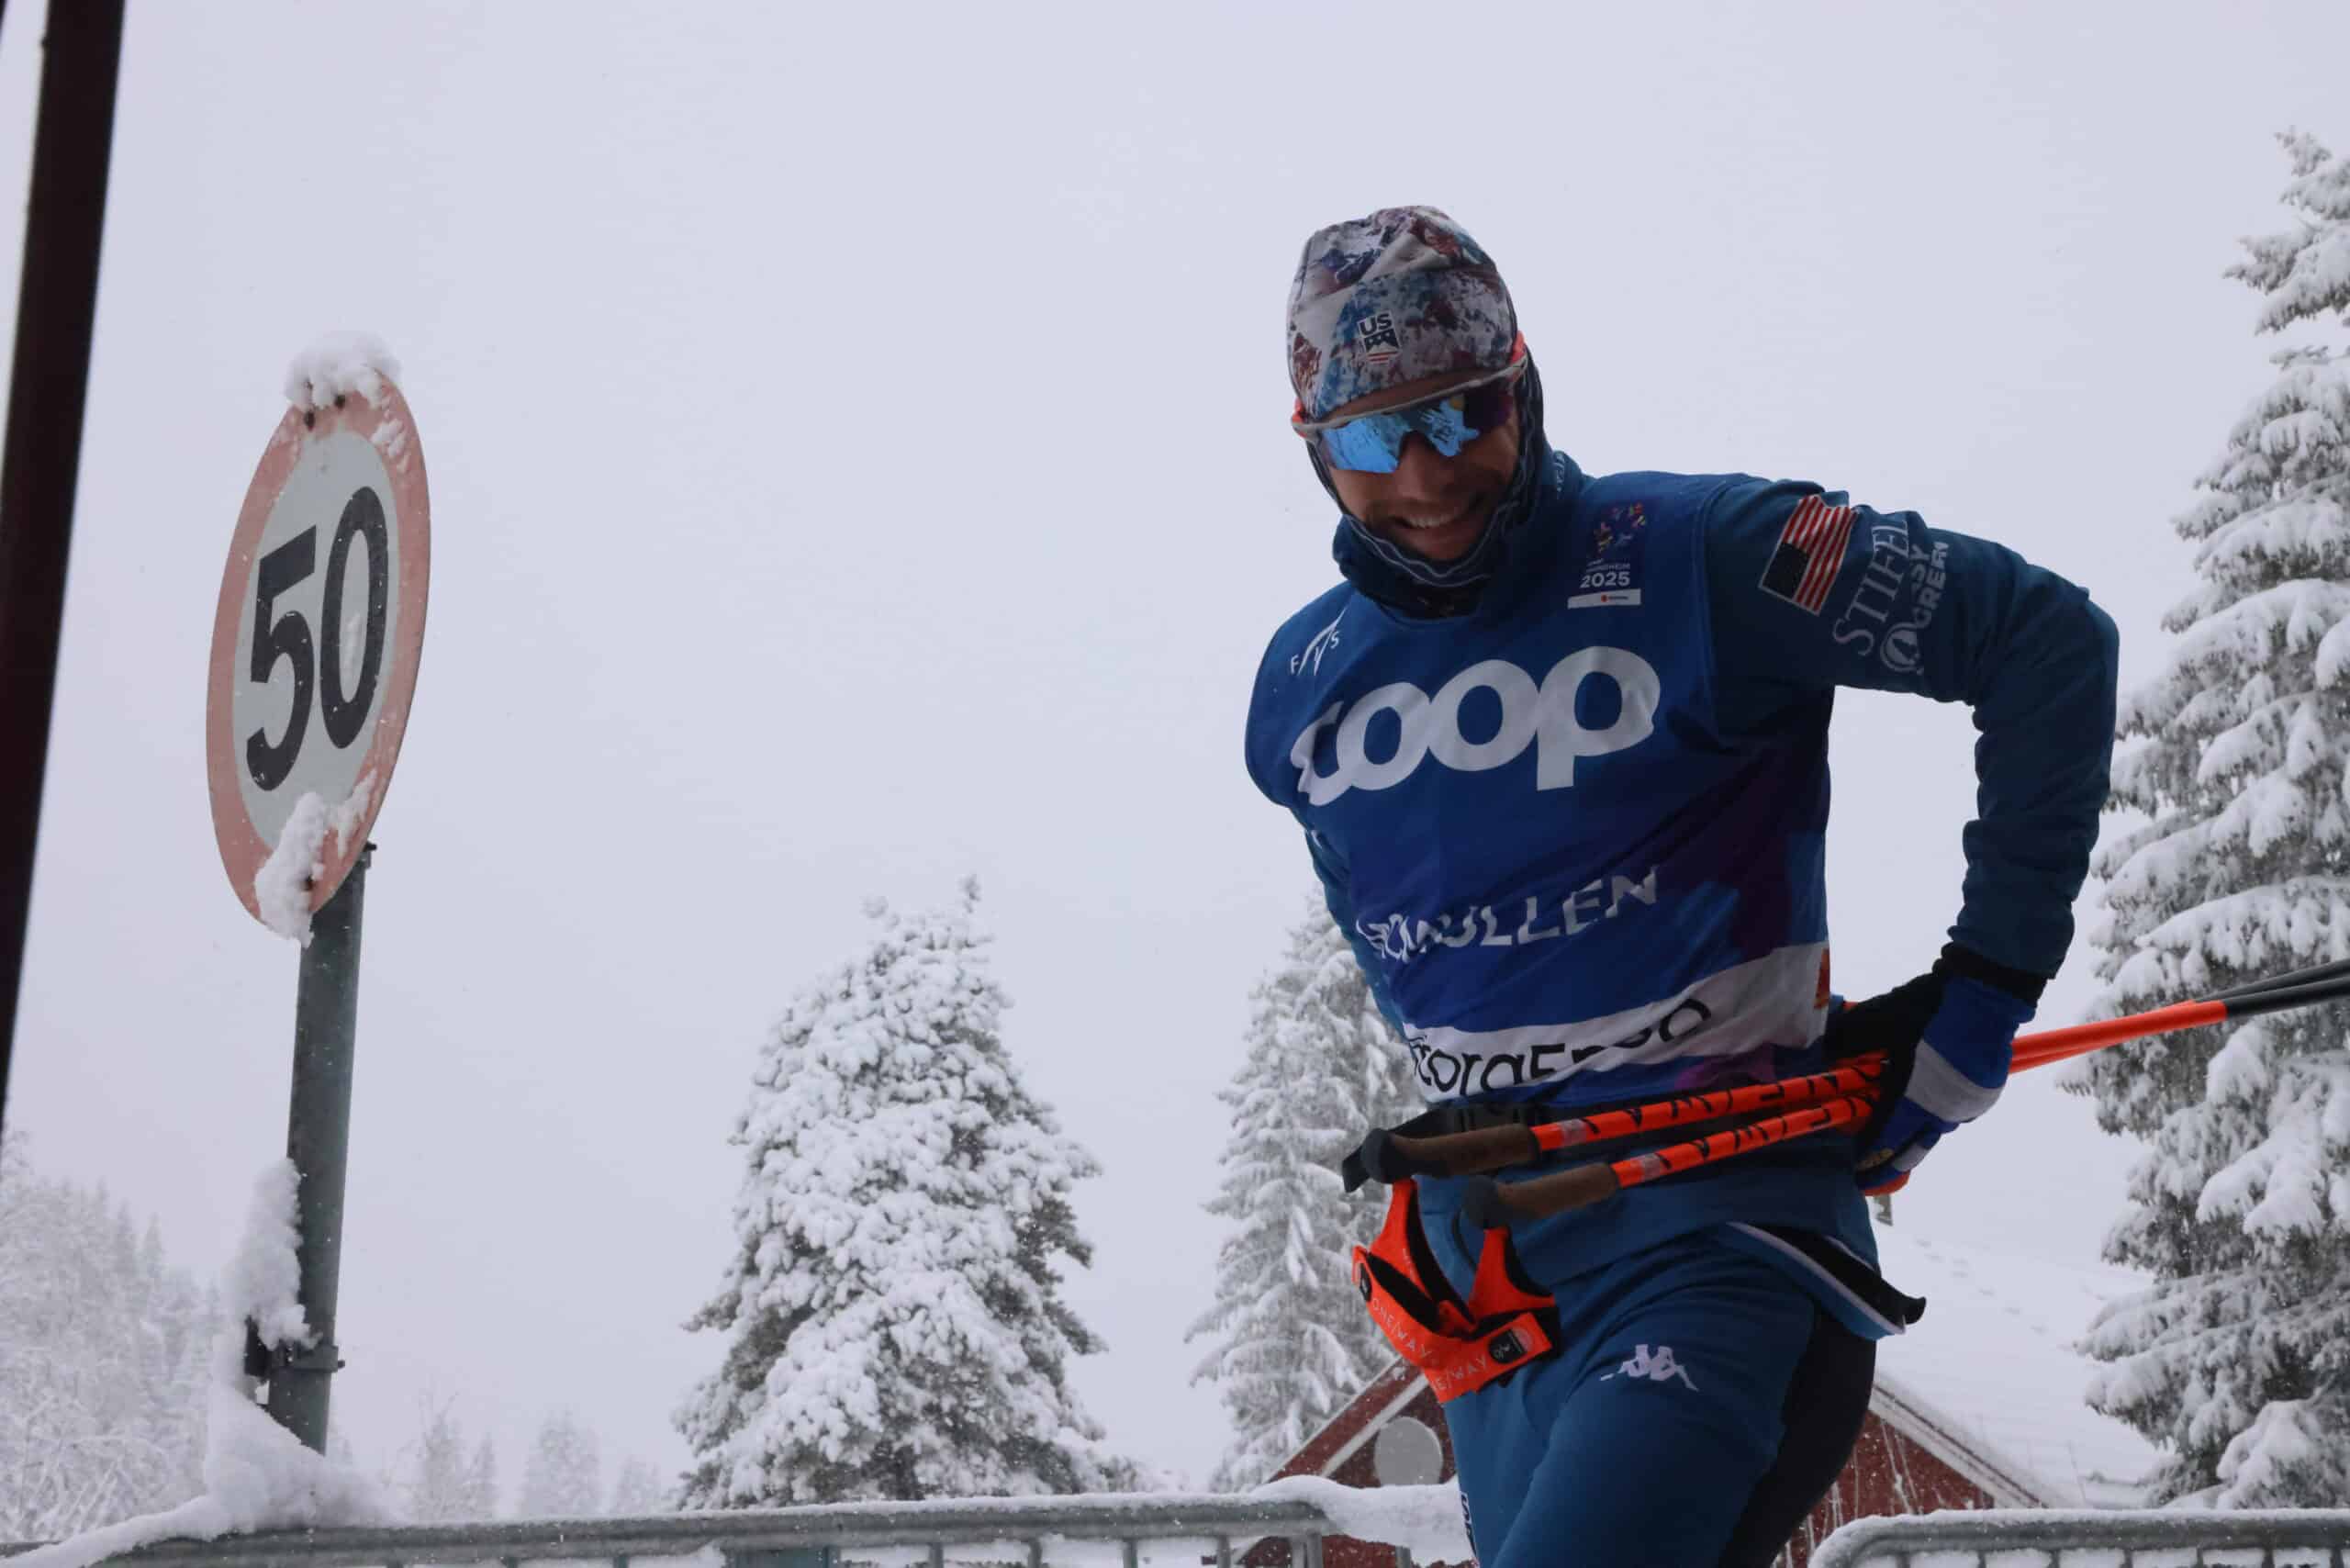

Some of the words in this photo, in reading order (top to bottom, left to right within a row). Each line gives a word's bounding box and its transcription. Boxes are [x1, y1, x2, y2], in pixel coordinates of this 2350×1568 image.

[1359, 313, 1392, 336] US
[246, 486, 389, 791] 50
[1580, 570, 1630, 589] 2025
[1833, 521, 1909, 656] STIFEL
[1291, 645, 1661, 806] coop
